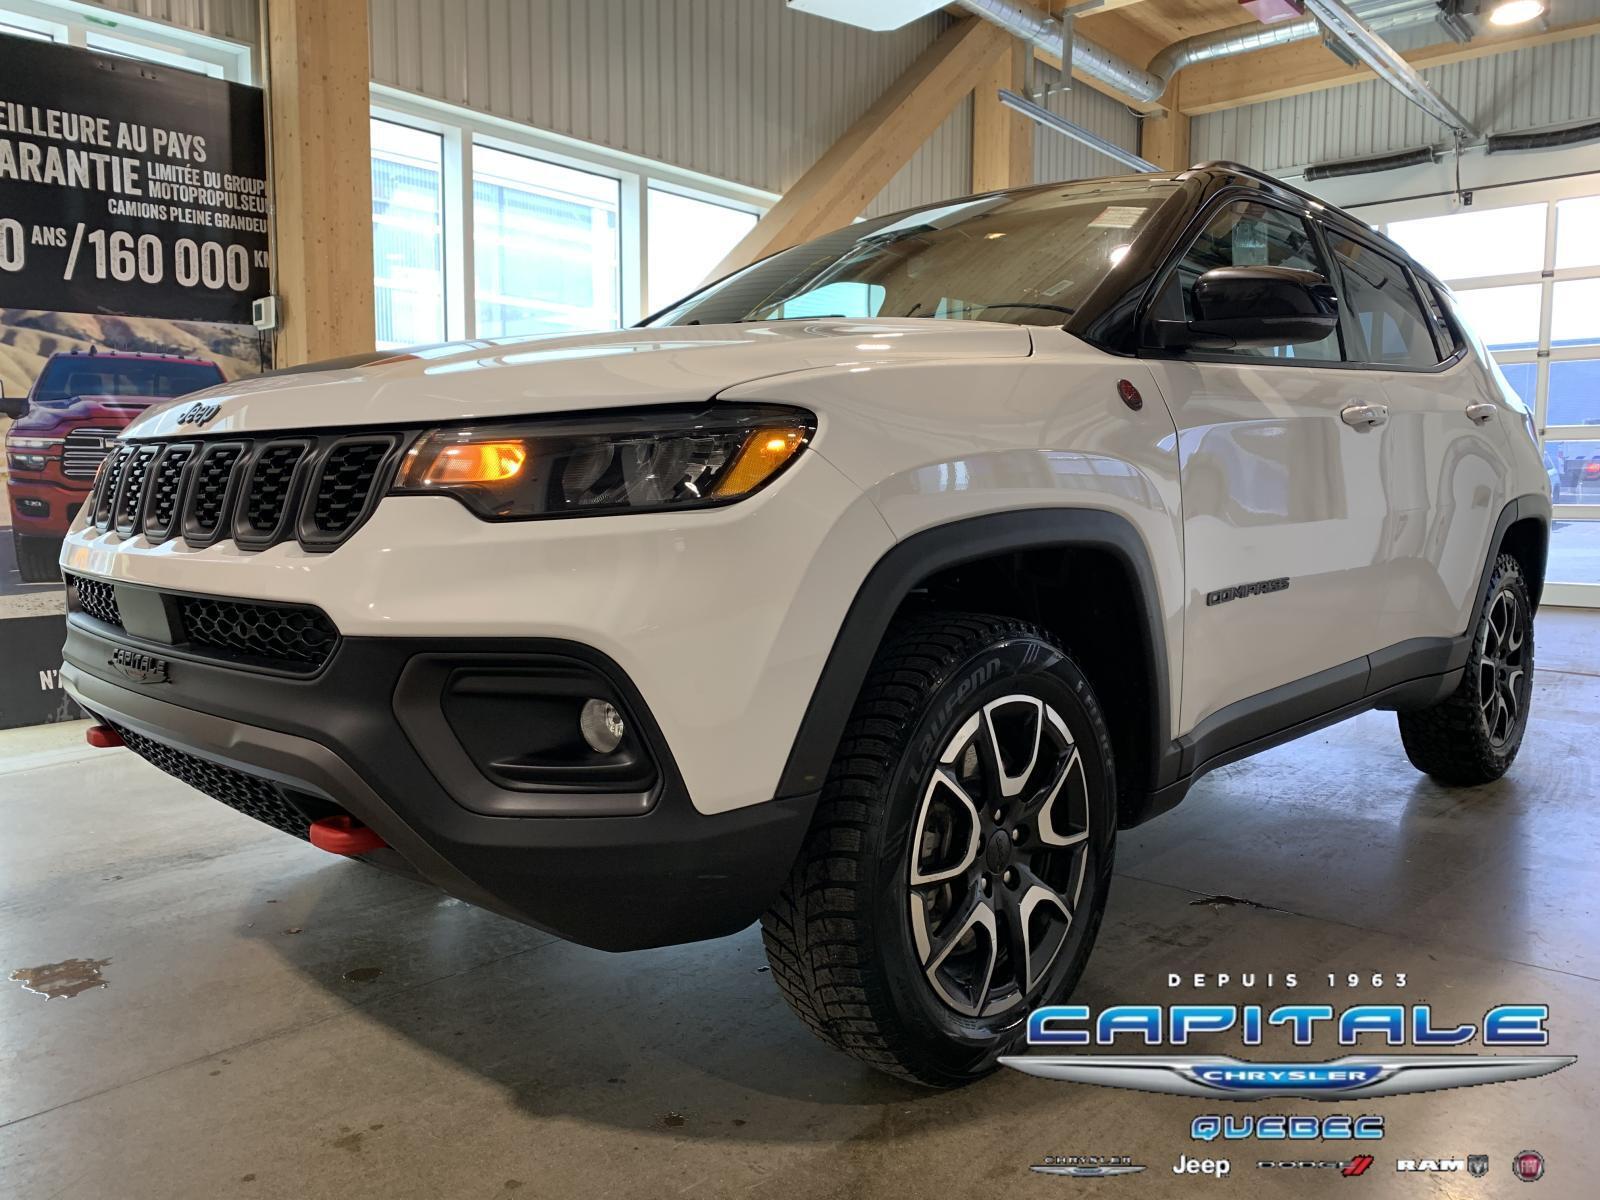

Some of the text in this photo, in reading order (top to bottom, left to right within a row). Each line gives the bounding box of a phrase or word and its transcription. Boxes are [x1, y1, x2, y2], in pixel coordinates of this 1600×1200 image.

[116, 122, 147, 152] AU
[152, 127, 207, 163] PAYS
[147, 161, 268, 197] LIMITÉE DU GROUP
[107, 199, 168, 221] CAMIONS
[170, 209, 213, 227] PLEINE
[149, 181, 268, 214] MOTOPROPULSEU
[31, 225, 67, 248] ANS
[175, 238, 250, 291] 000
[177, 402, 221, 427] Jeep
[1206, 577, 1290, 606] COMPASS
